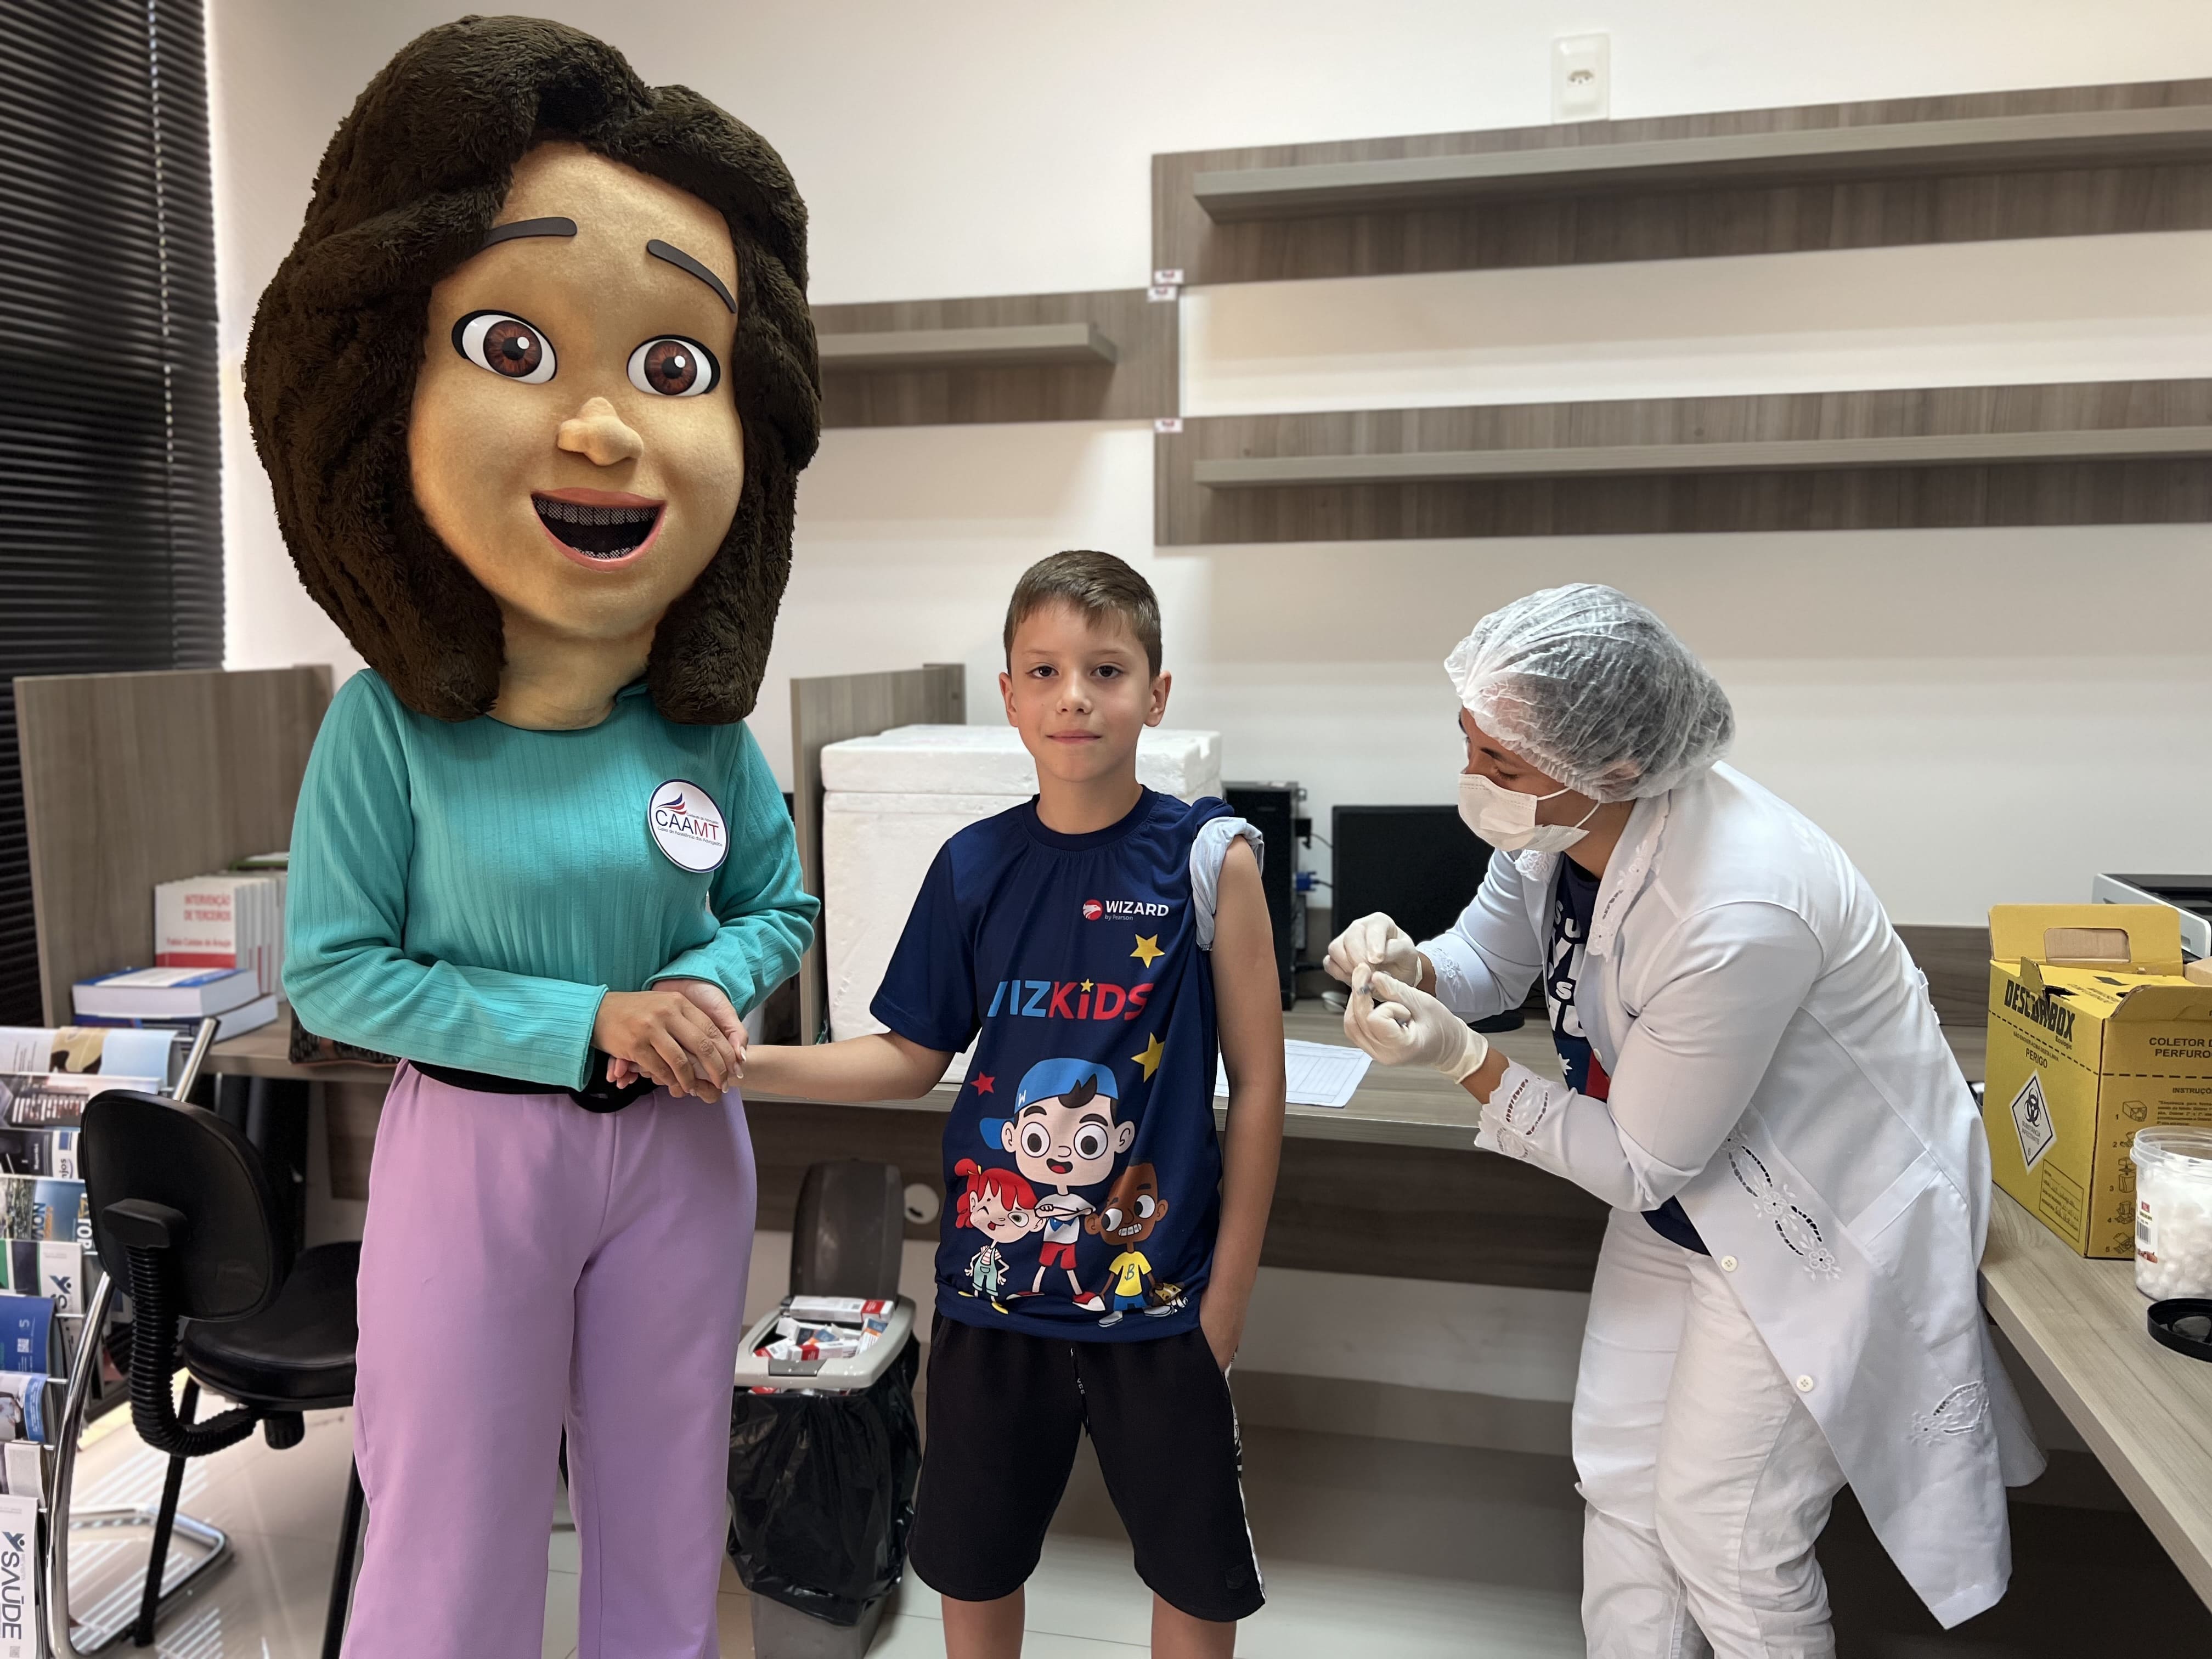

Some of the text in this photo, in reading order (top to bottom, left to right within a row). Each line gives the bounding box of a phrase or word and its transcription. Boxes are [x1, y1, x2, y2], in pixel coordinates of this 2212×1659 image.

[656, 810, 719, 840] CAAMT
[1105, 900, 1169, 917] WIZARD
[2149, 1037, 2205, 1047] COLETOR
[2025, 1047, 2048, 1069] PERIGO
[2154, 1049, 2212, 1058] PERFURO
